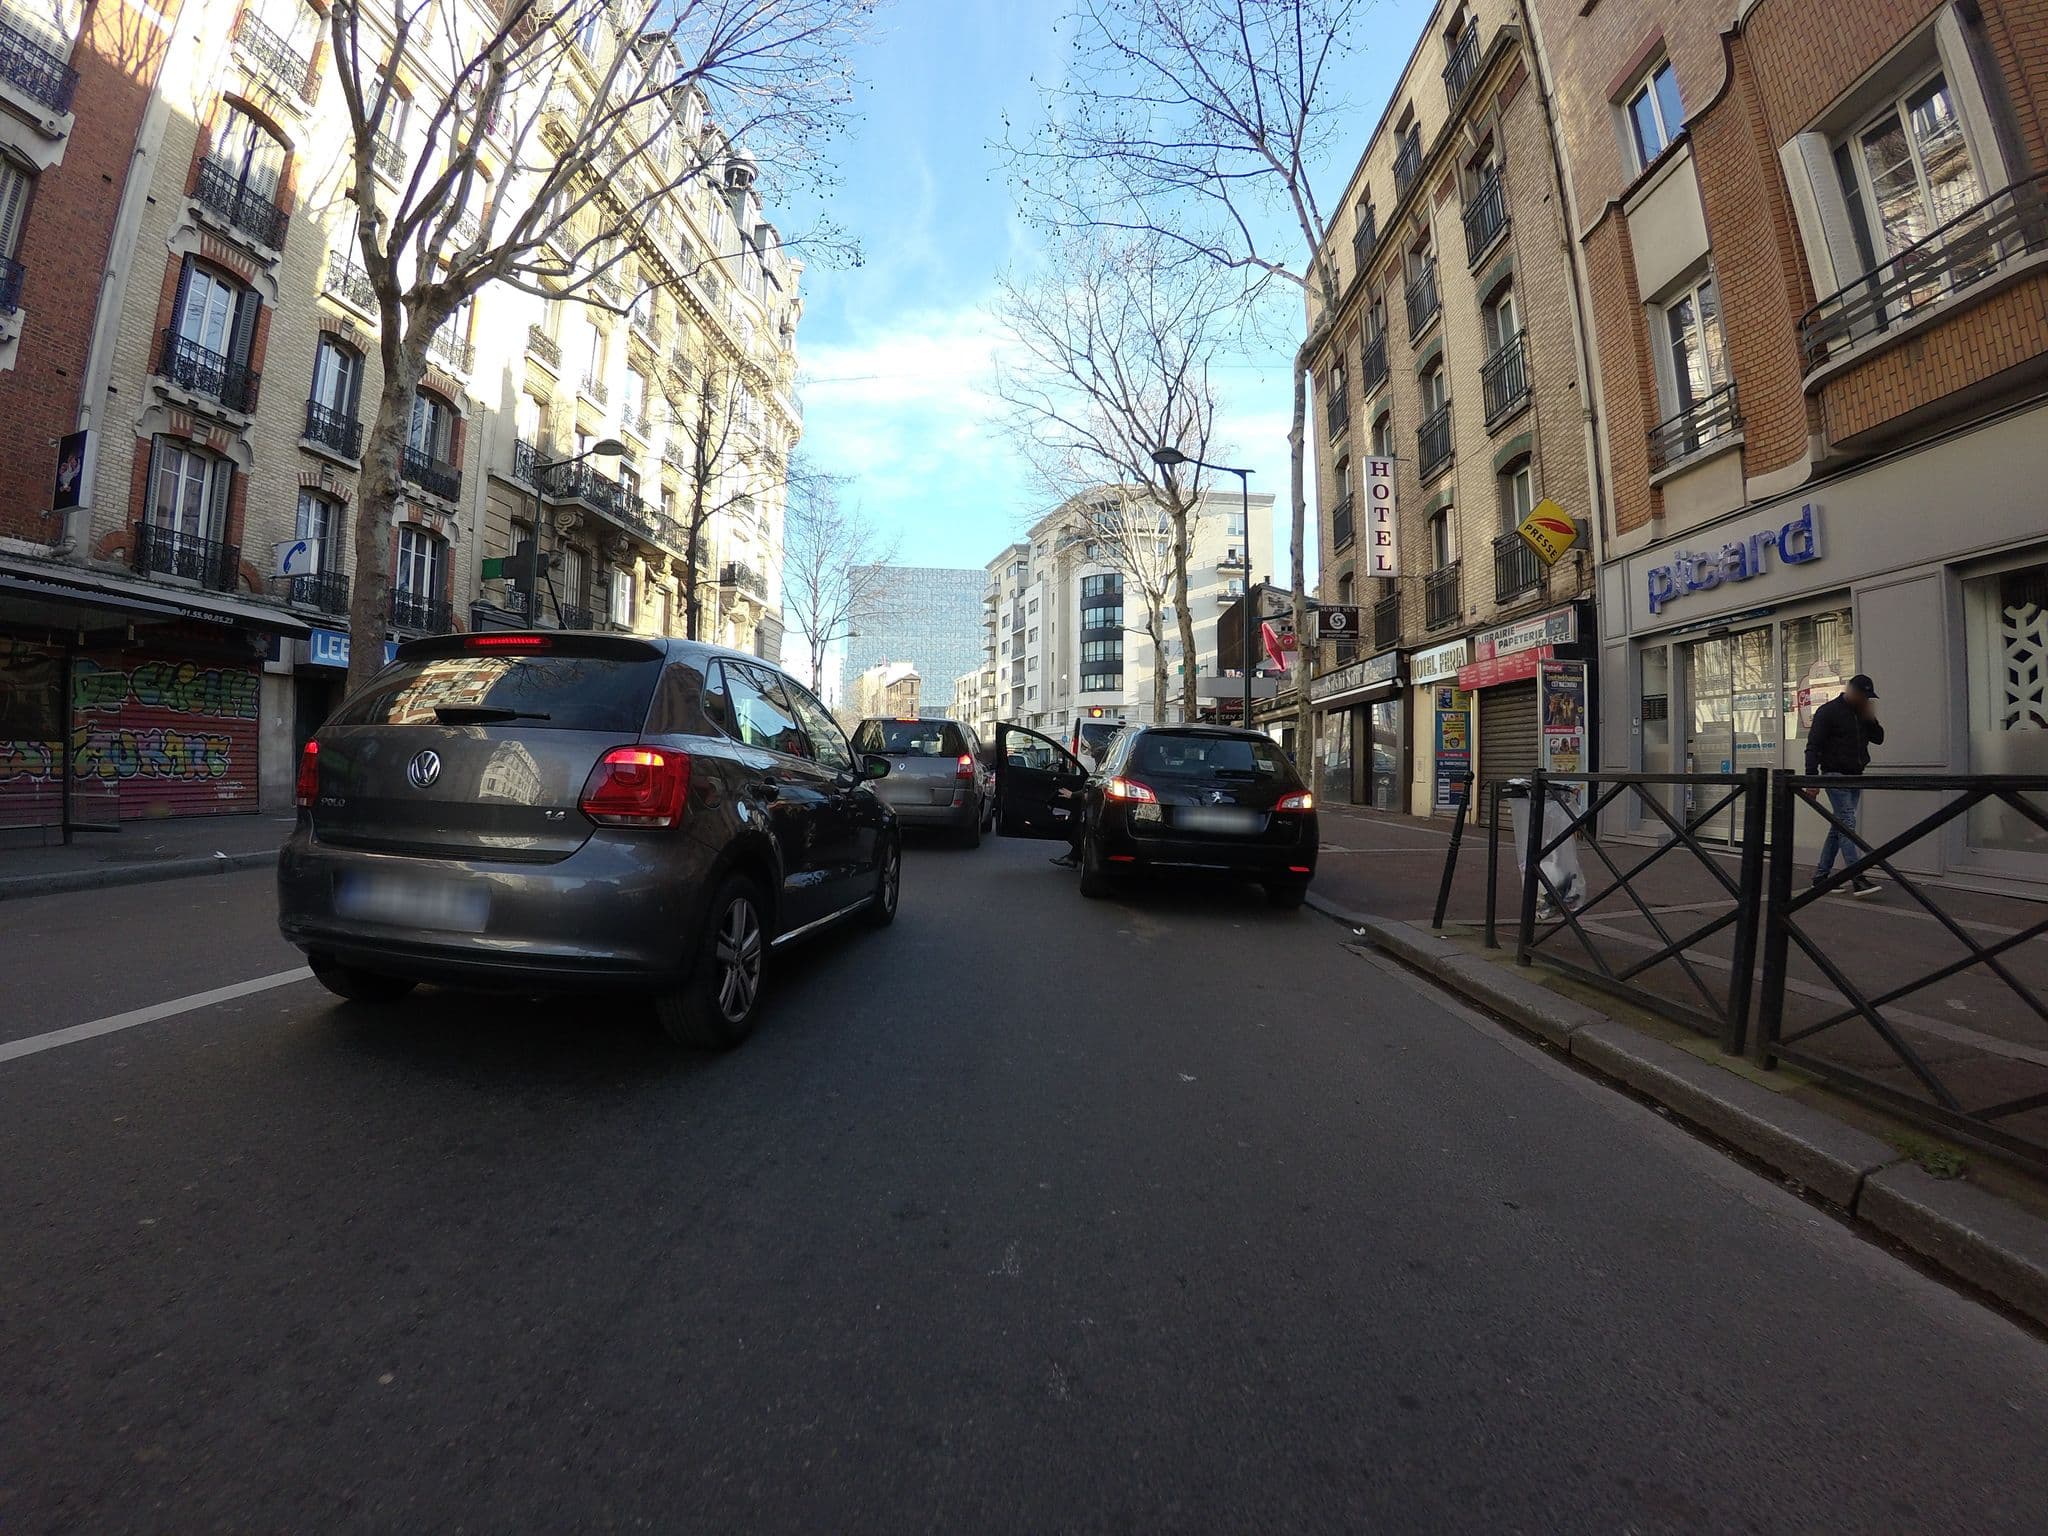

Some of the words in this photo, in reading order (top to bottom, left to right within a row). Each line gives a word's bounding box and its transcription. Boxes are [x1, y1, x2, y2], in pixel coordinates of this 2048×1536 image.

[1370, 461, 1392, 572] HOTEL
[1523, 523, 1559, 560] PRESSE
[1647, 503, 1823, 616] picard
[1477, 626, 1515, 646] LIBRAIRIE
[1498, 629, 1545, 650] PAPETERIE
[320, 797, 346, 808] POLO
